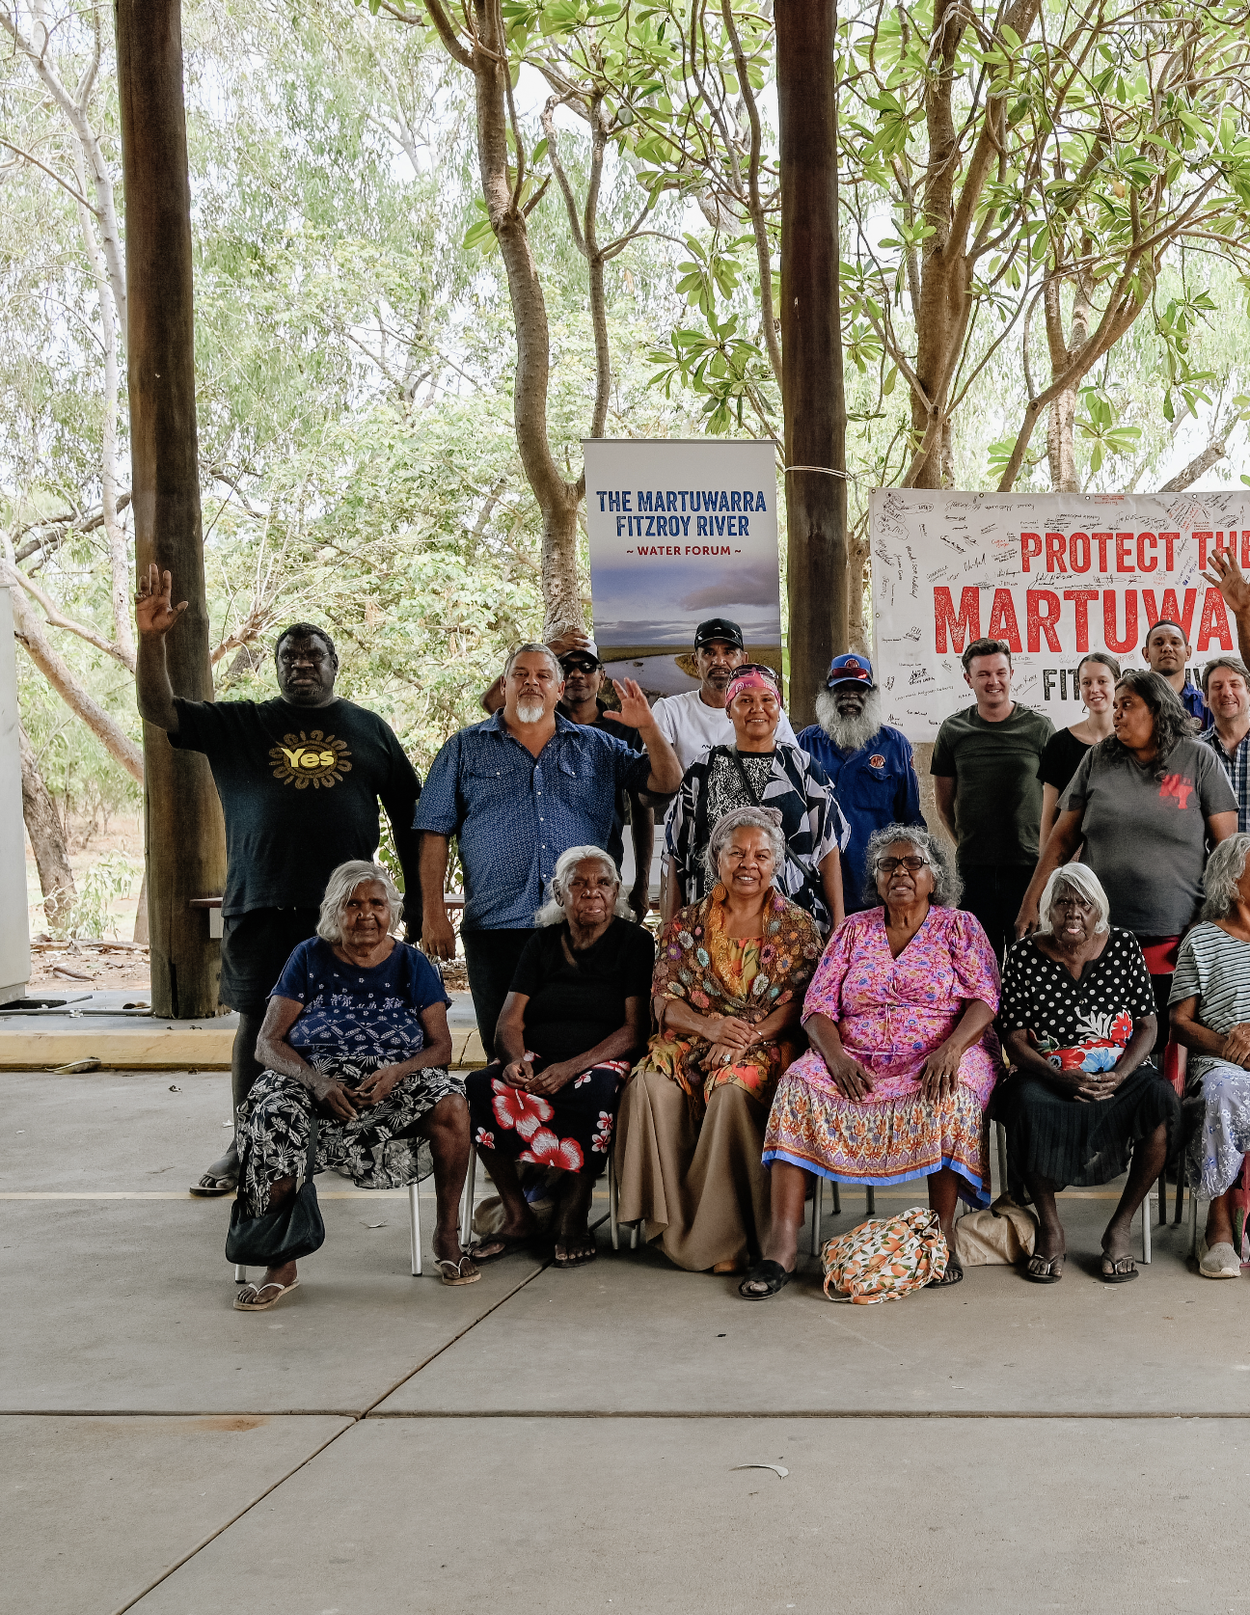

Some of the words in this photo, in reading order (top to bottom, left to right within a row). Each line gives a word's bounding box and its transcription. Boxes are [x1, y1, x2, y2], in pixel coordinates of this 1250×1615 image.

[596, 491, 633, 512] THE
[637, 491, 767, 512] MARTUWARRA
[616, 515, 691, 537] FITZROY
[696, 515, 750, 537] RIVER
[637, 545, 682, 556] WATER
[685, 545, 731, 556] FORUM
[1020, 531, 1181, 574] PROTECT
[280, 747, 335, 768] Yes
